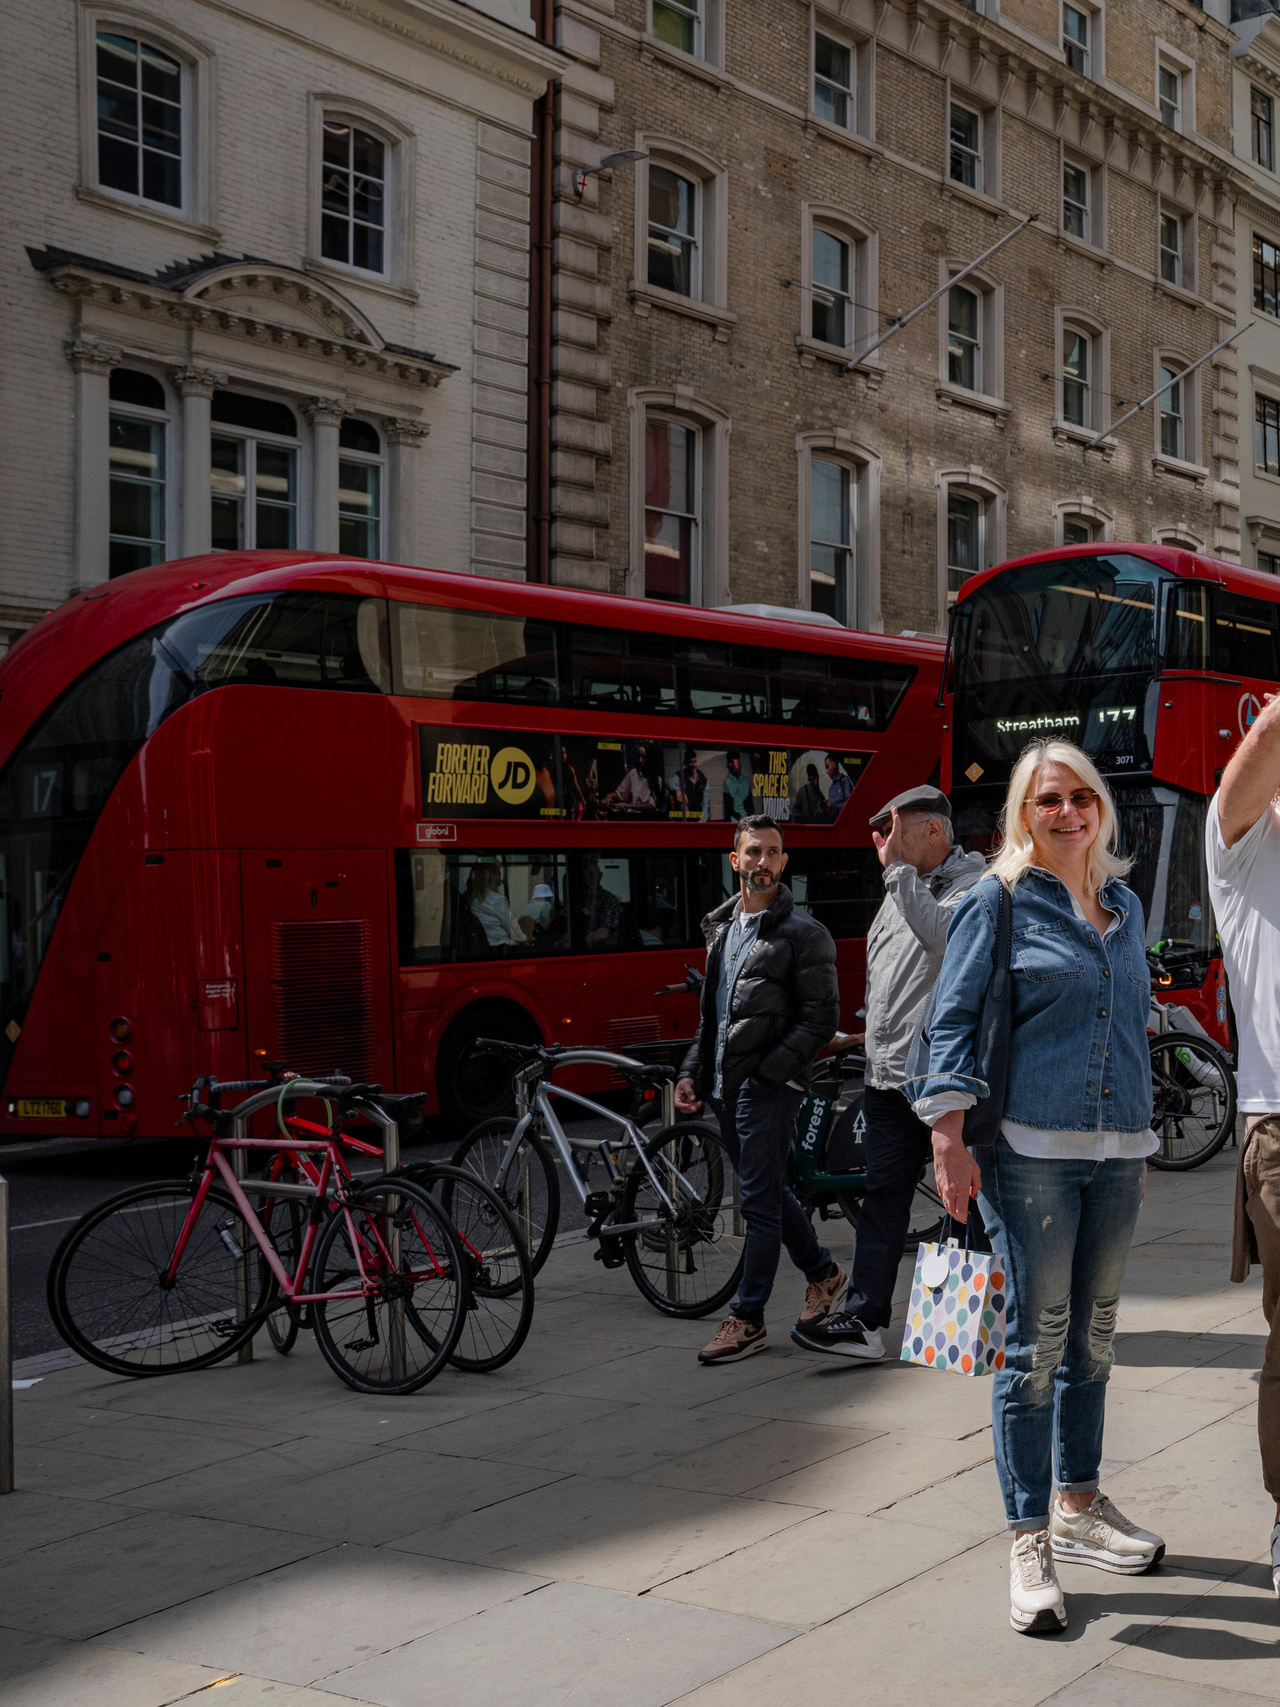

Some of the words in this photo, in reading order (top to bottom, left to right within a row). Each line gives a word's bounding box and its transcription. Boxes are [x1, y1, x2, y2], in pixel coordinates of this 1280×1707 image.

[996, 716, 1080, 733] Streatham
[1098, 706, 1137, 723] 177
[436, 743, 491, 775] FOREVER
[768, 751, 788, 774] THIS
[1115, 755, 1134, 765] 3071
[427, 773, 489, 804] FORWARD
[498, 761, 531, 790] JD
[752, 773, 779, 797] SPACE
[779, 774, 789, 798] IS
[763, 797, 790, 821] YOURS
[425, 828, 450, 838] global
[801, 1097, 826, 1151] forest
